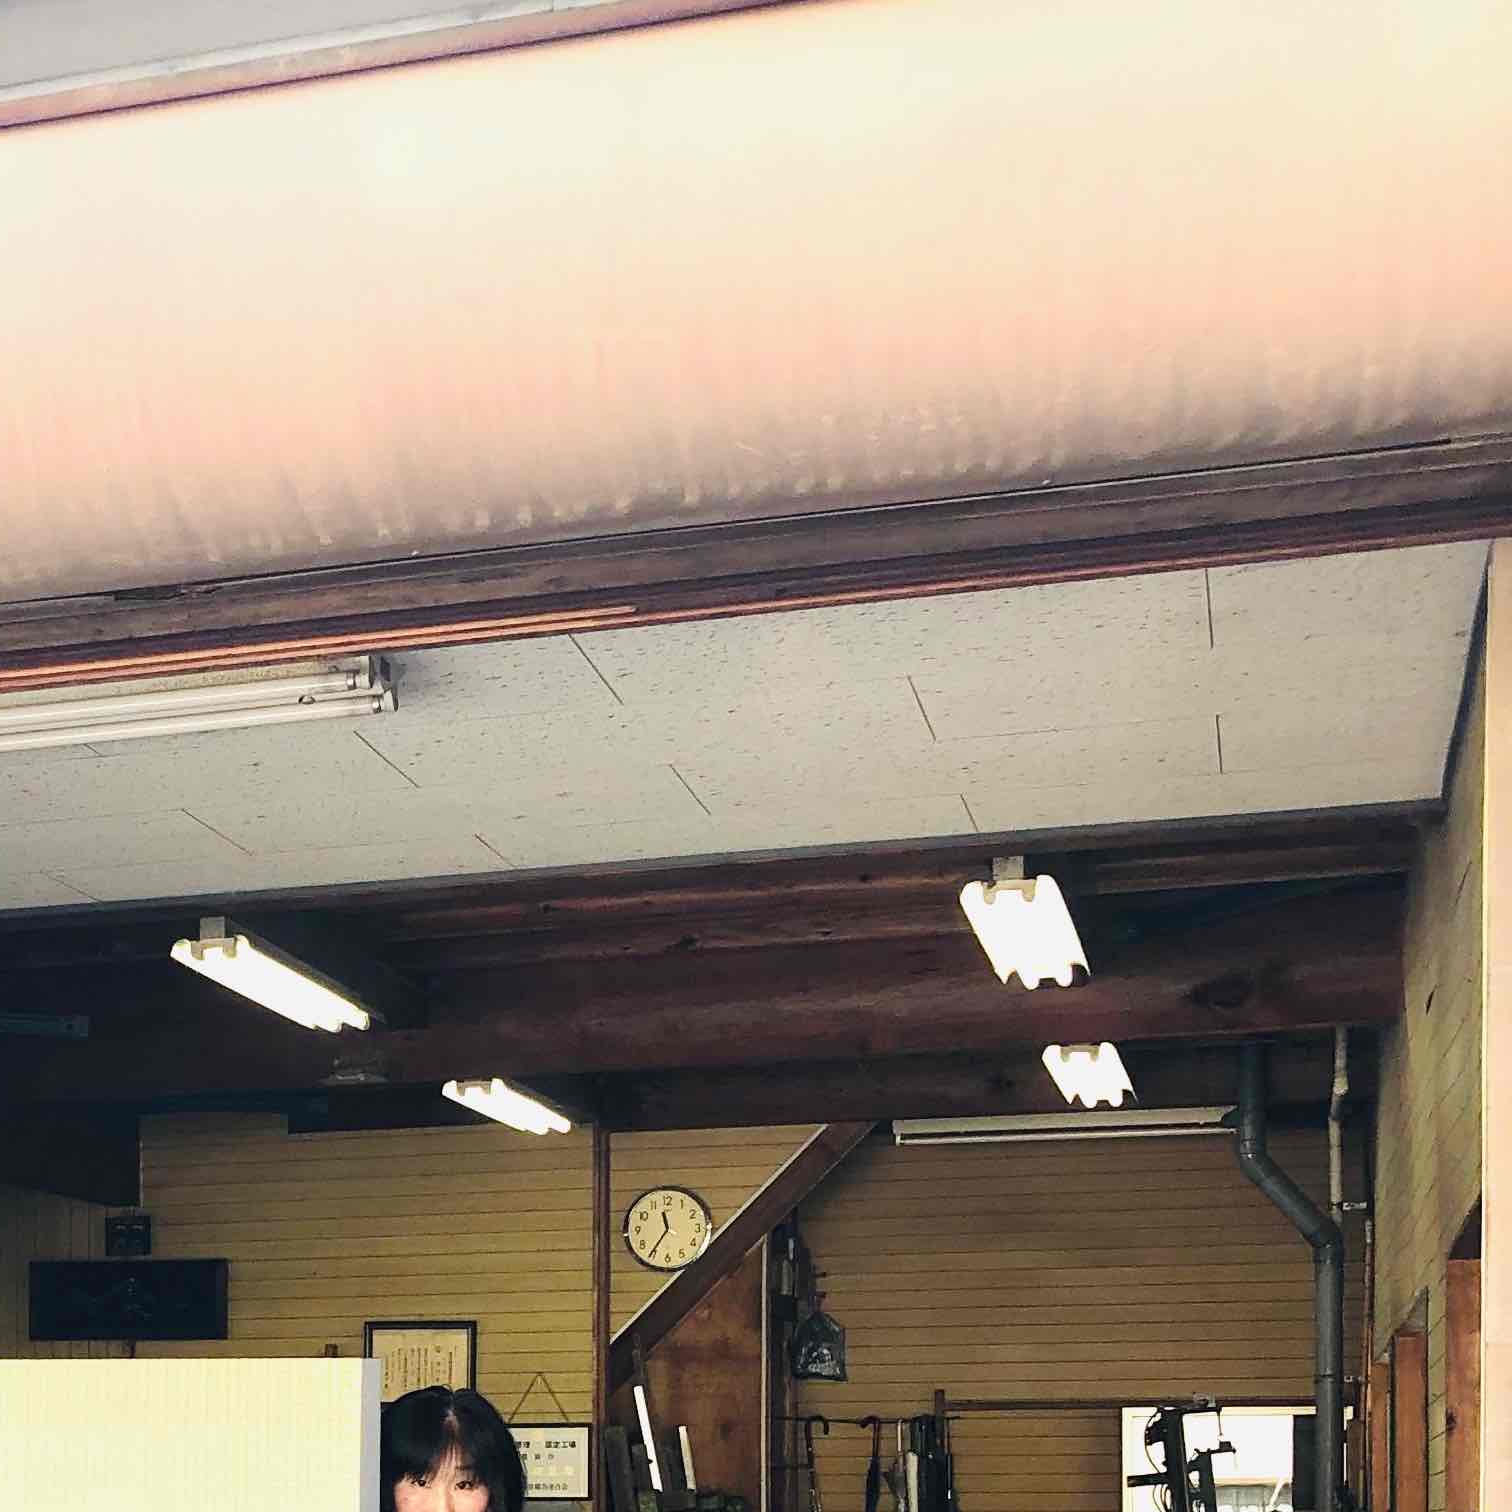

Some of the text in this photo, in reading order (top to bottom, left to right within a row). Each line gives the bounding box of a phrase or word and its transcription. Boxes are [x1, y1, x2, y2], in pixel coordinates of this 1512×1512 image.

[650, 1200, 657, 1210] 11
[663, 1195, 672, 1206] 12
[639, 1211, 648, 1221] 10
[689, 1209, 696, 1219] 2
[634, 1226, 641, 1235] 9
[695, 1223, 701, 1233] 3
[639, 1240, 646, 1249] 8
[690, 1238, 696, 1247] 4
[664, 1252, 671, 1262] 6
[678, 1248, 685, 1258] 5
